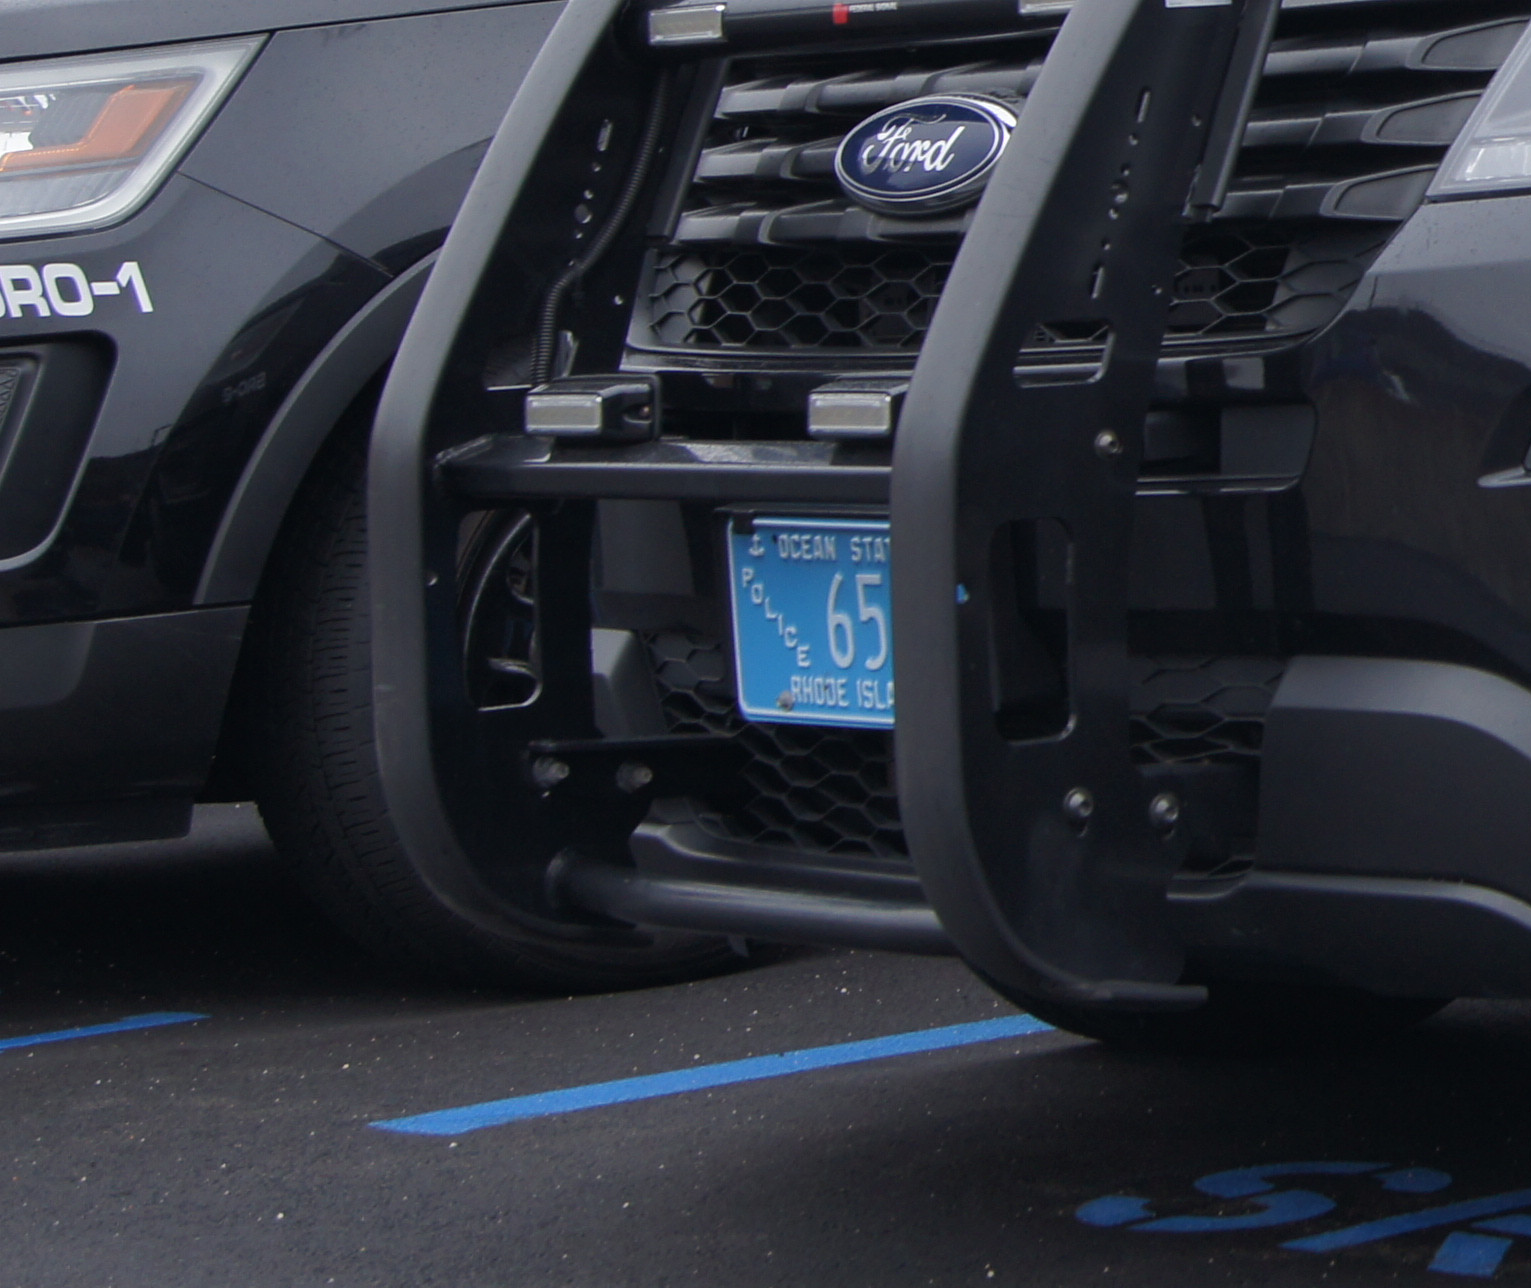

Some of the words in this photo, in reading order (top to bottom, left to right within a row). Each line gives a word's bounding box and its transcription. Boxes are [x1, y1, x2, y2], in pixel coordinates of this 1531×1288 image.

[860, 113, 966, 176] Ford
[0, 261, 154, 318] RO-1
[776, 533, 836, 561] OCEAN
[741, 567, 811, 669] POLICE
